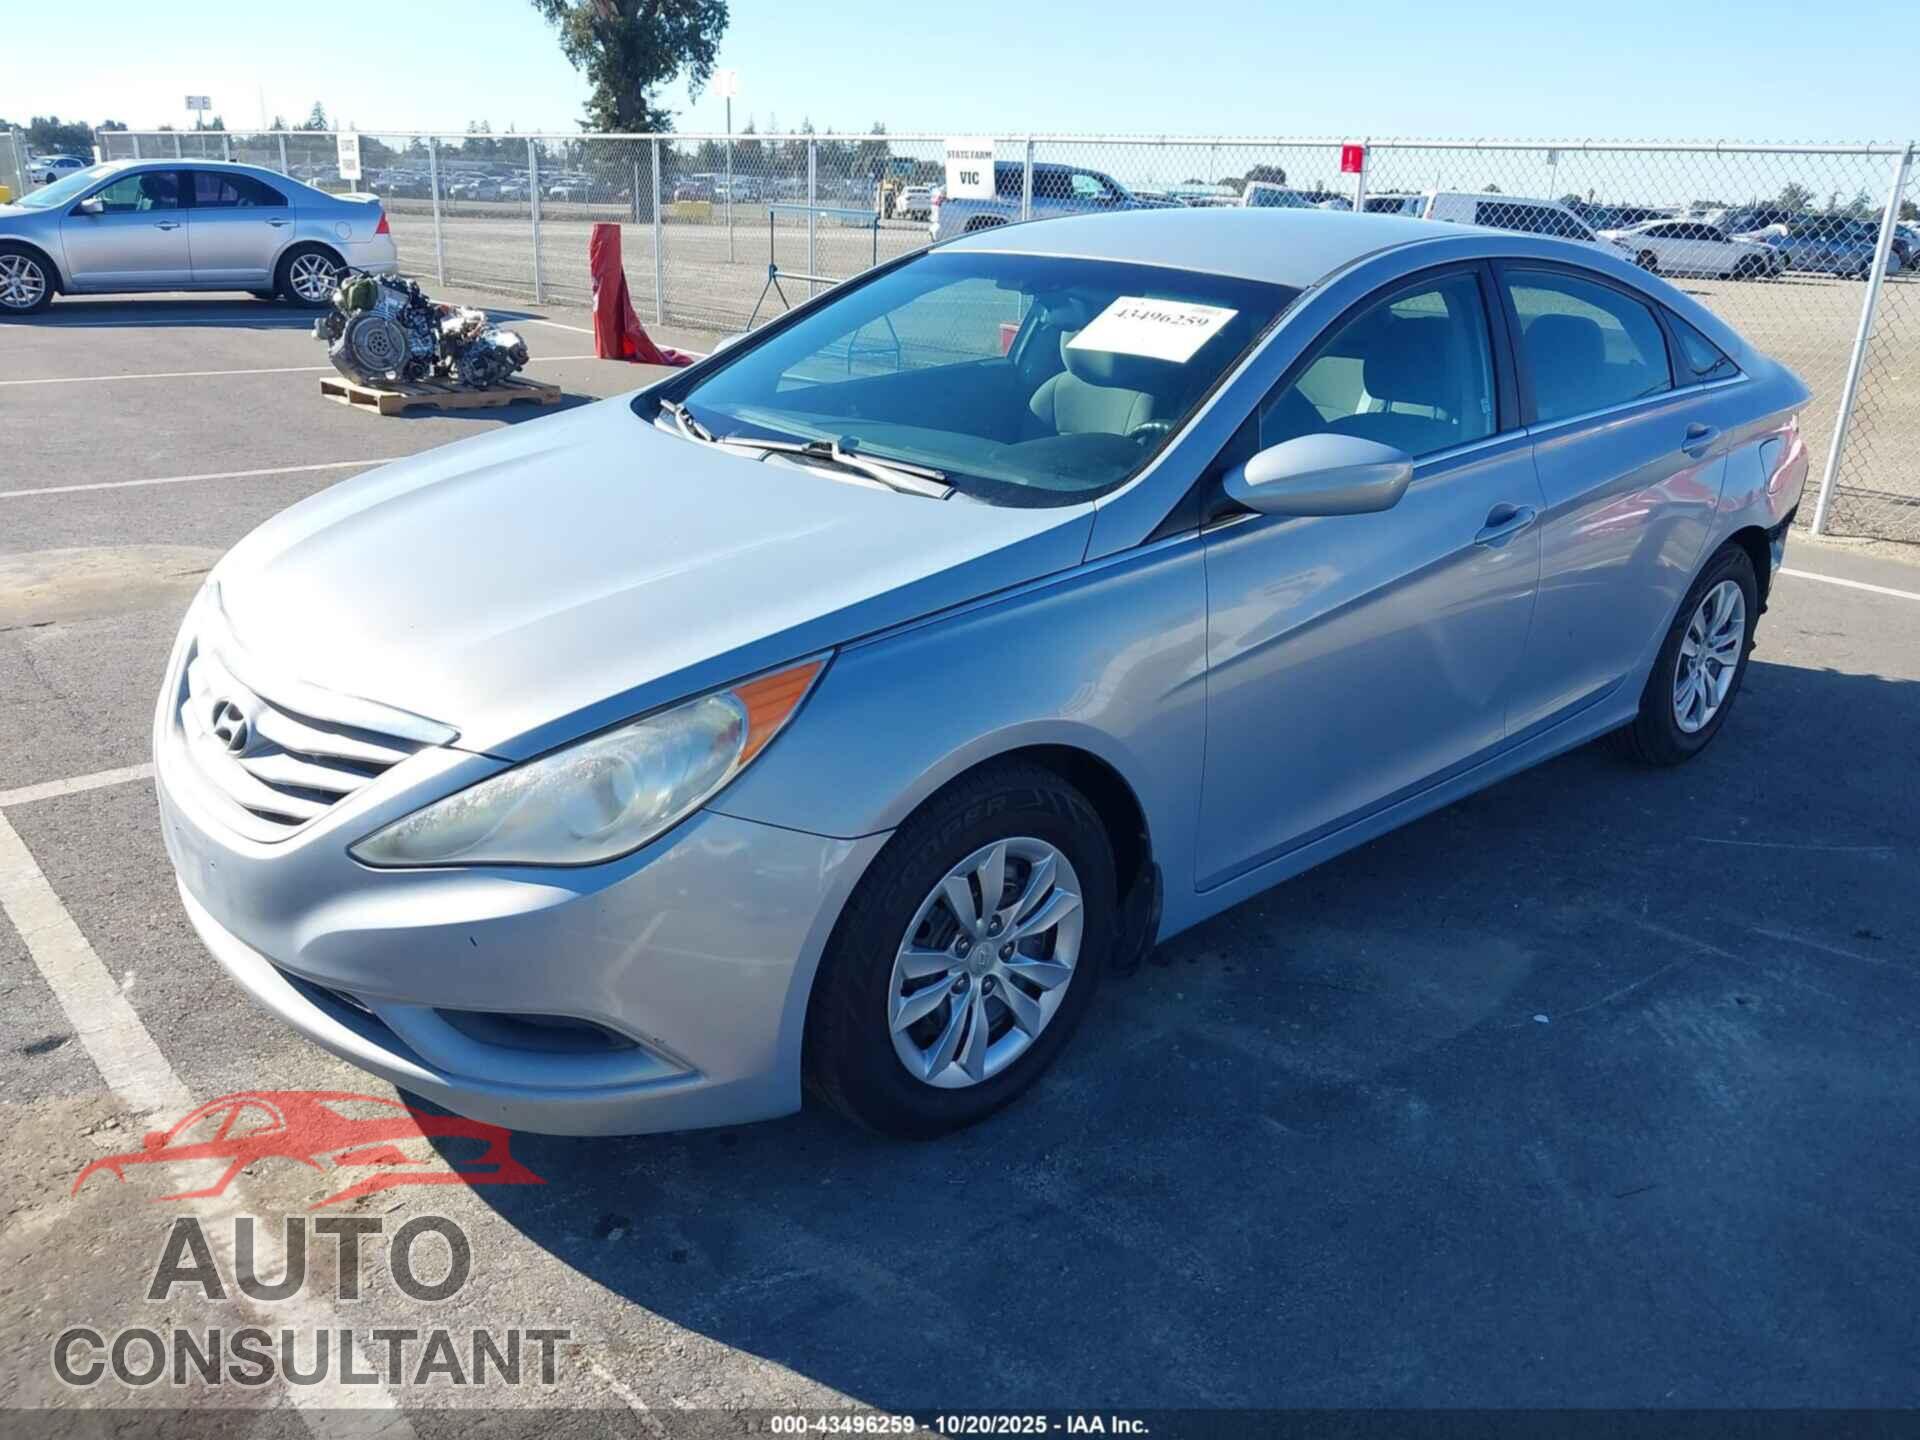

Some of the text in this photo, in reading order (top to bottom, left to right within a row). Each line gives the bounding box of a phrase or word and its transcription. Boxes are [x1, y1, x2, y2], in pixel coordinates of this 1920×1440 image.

[970, 150, 992, 160] FARM
[959, 171, 979, 185] VIC
[1113, 308, 1210, 327] 43496259
